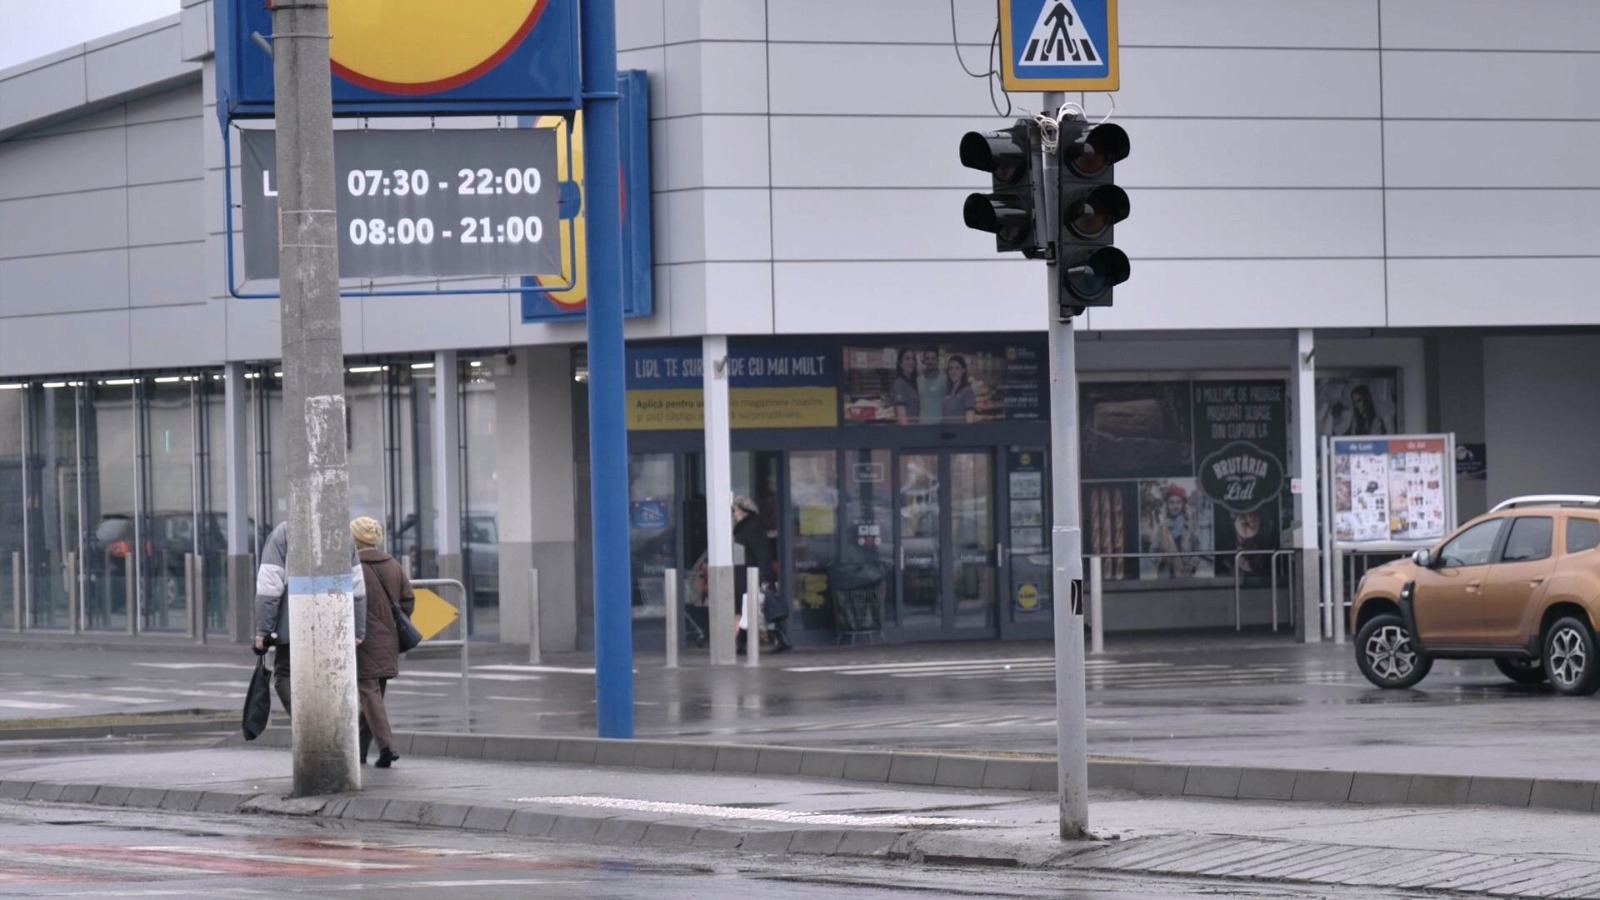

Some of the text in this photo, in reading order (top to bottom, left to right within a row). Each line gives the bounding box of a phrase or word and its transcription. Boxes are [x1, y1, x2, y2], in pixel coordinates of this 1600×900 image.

[347, 169, 430, 197] 07:30
[457, 167, 541, 195] 22:00
[349, 217, 434, 246] 08:00
[460, 215, 543, 244] 21:00
[635, 359, 661, 379] LIDL
[663, 358, 678, 377] TE
[748, 356, 763, 376] CU
[767, 356, 789, 376] MAI
[792, 355, 826, 376] MULT
[1223, 482, 1256, 500] Lidl
